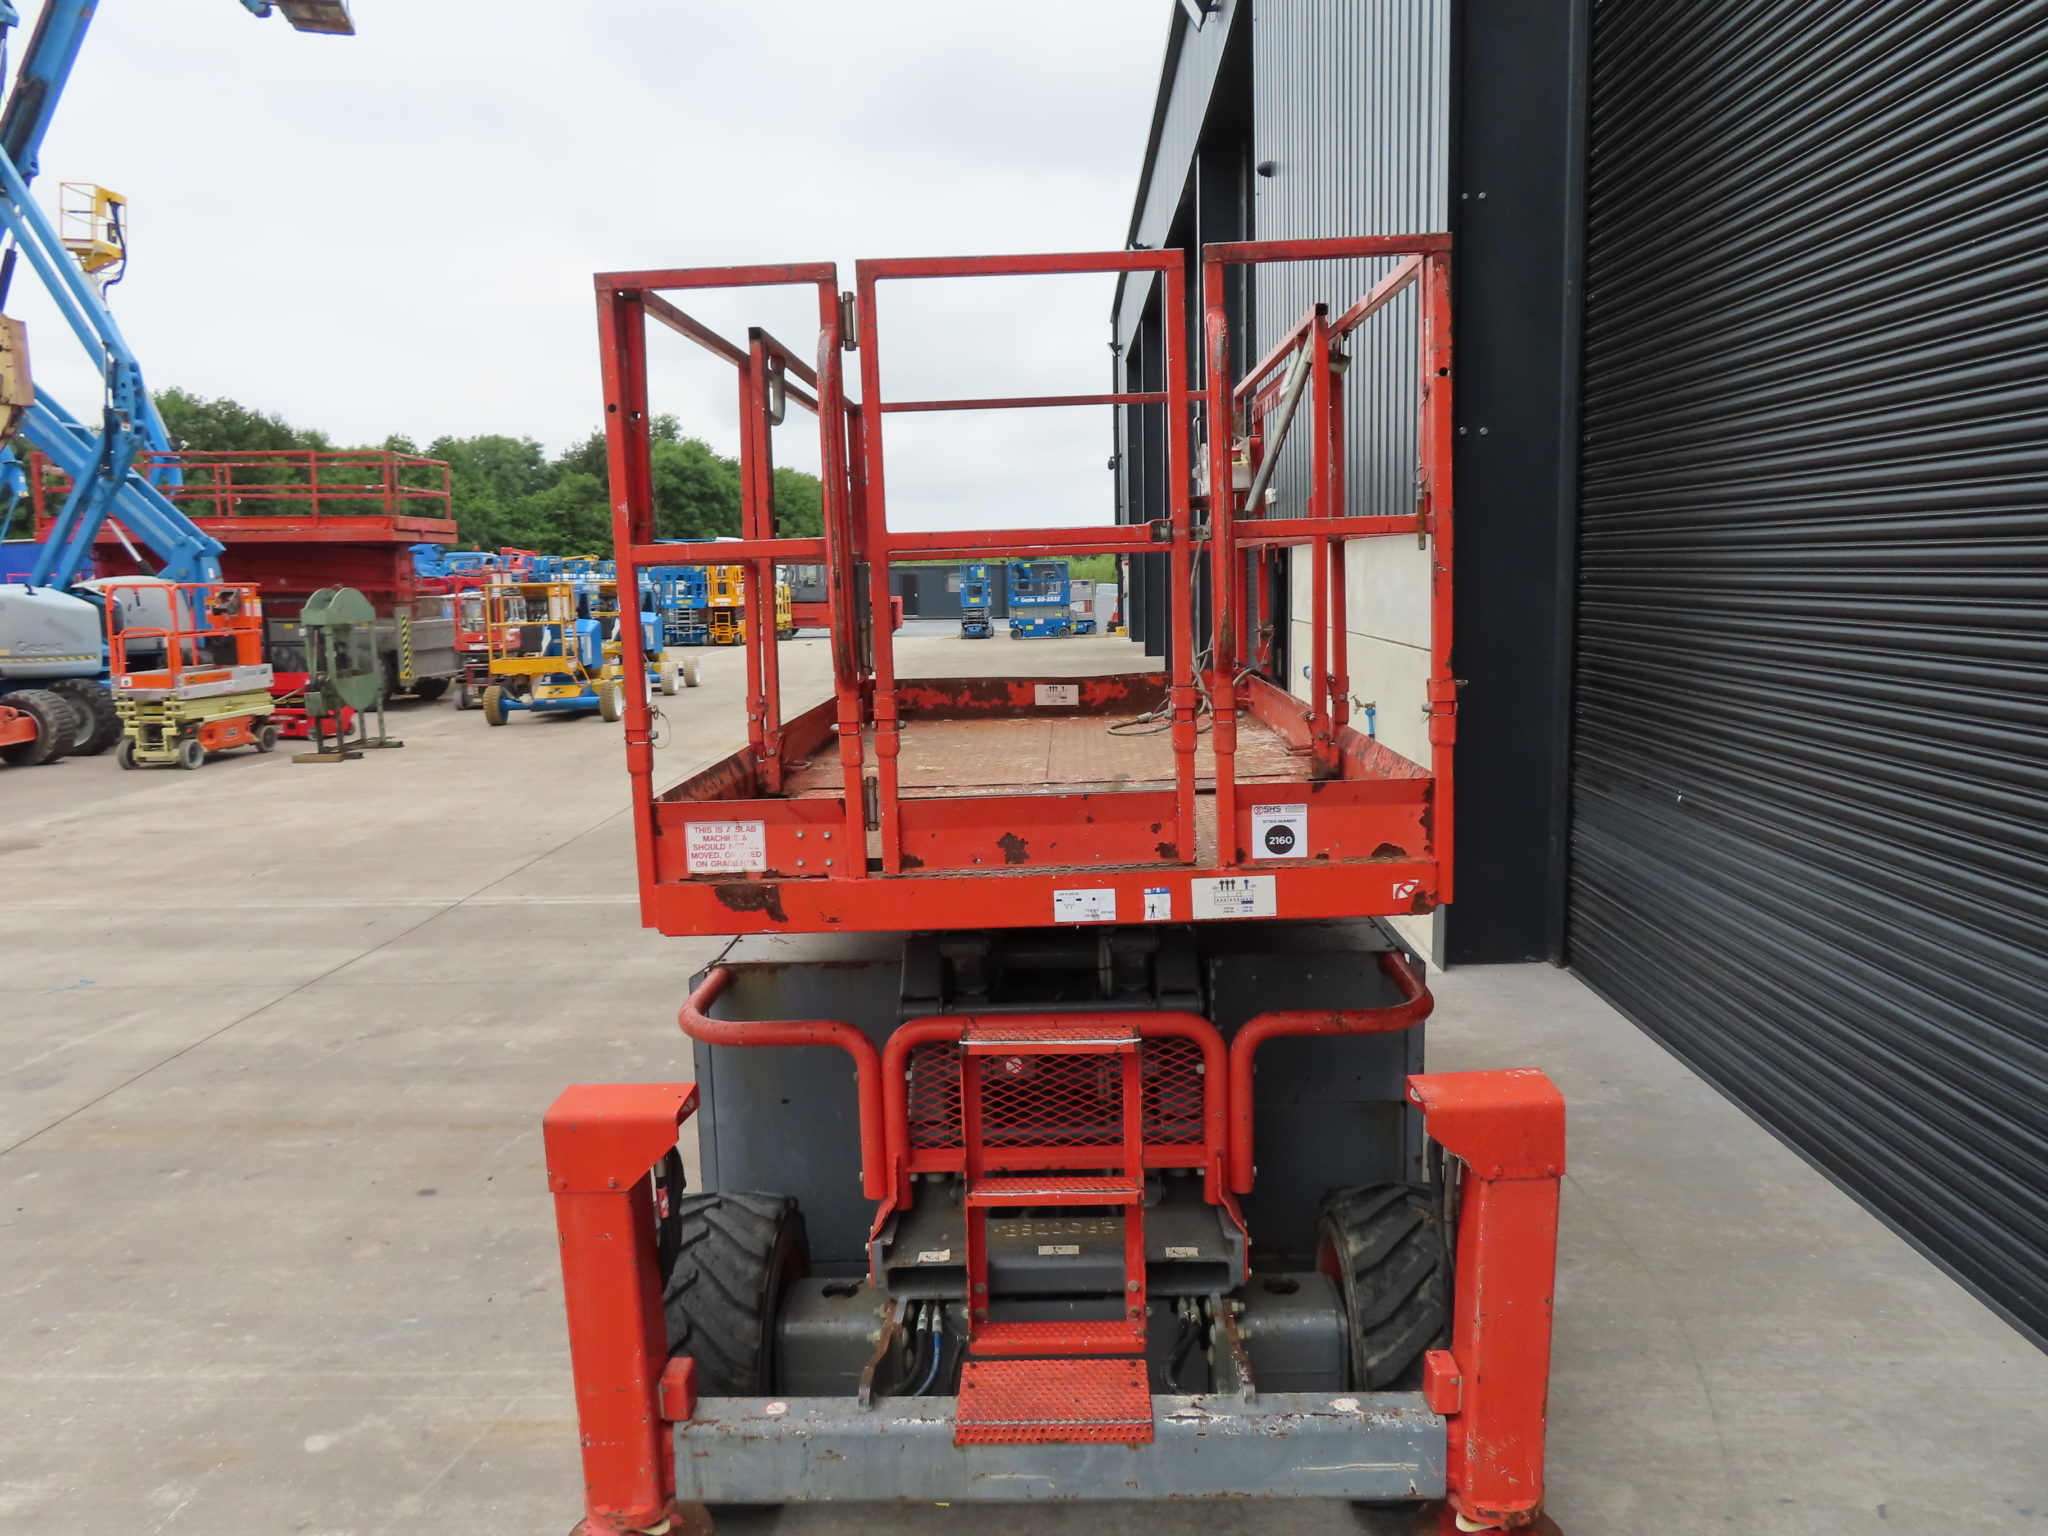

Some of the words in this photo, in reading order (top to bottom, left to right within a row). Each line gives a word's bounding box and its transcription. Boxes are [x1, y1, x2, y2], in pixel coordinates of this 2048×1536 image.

[694, 826, 712, 834] THIS
[715, 826, 723, 834] IS
[735, 825, 757, 833] SLAB
[1269, 836, 1293, 845] 2160
[693, 843, 726, 851] SHOULD
[691, 851, 722, 860] MOVED,
[740, 851, 762, 859] UED
